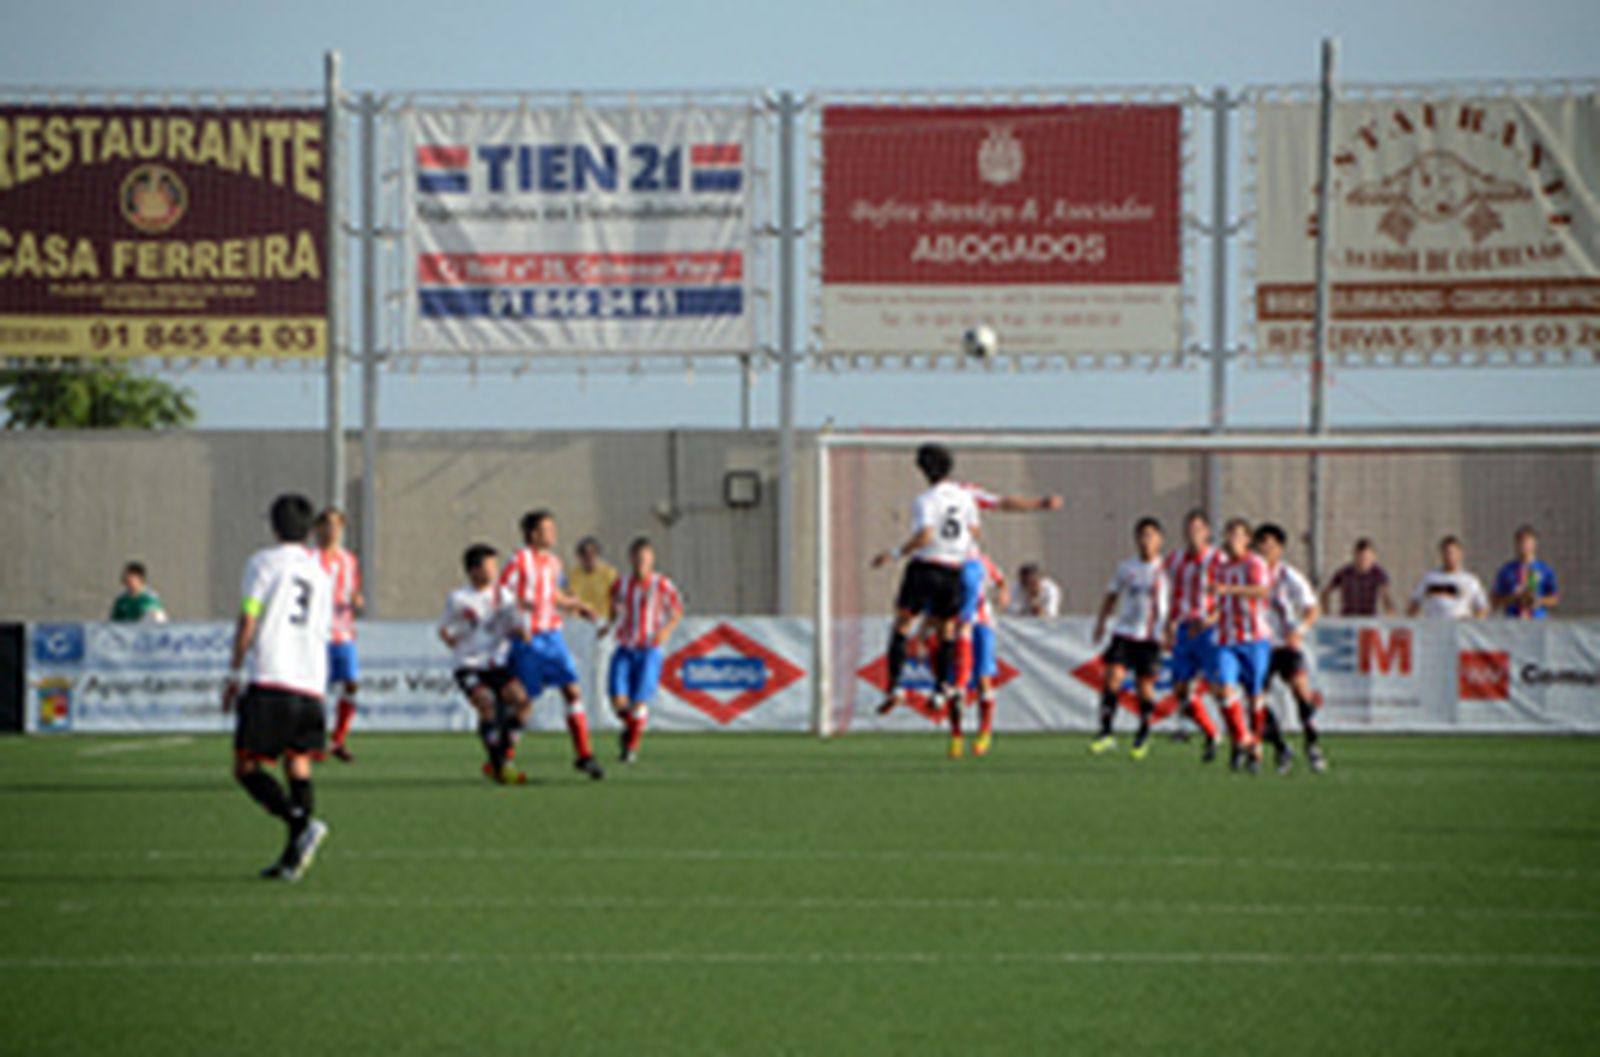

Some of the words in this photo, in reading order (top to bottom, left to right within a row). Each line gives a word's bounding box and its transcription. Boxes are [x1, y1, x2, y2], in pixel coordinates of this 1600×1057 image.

[477, 144, 617, 192] TIEN
[0, 227, 99, 278] CASA
[112, 230, 320, 280] FERREIRA
[910, 234, 1106, 263] ABOGADOS
[90, 324, 128, 349] 91
[220, 324, 260, 348] 44
[288, 576, 313, 625] 3
